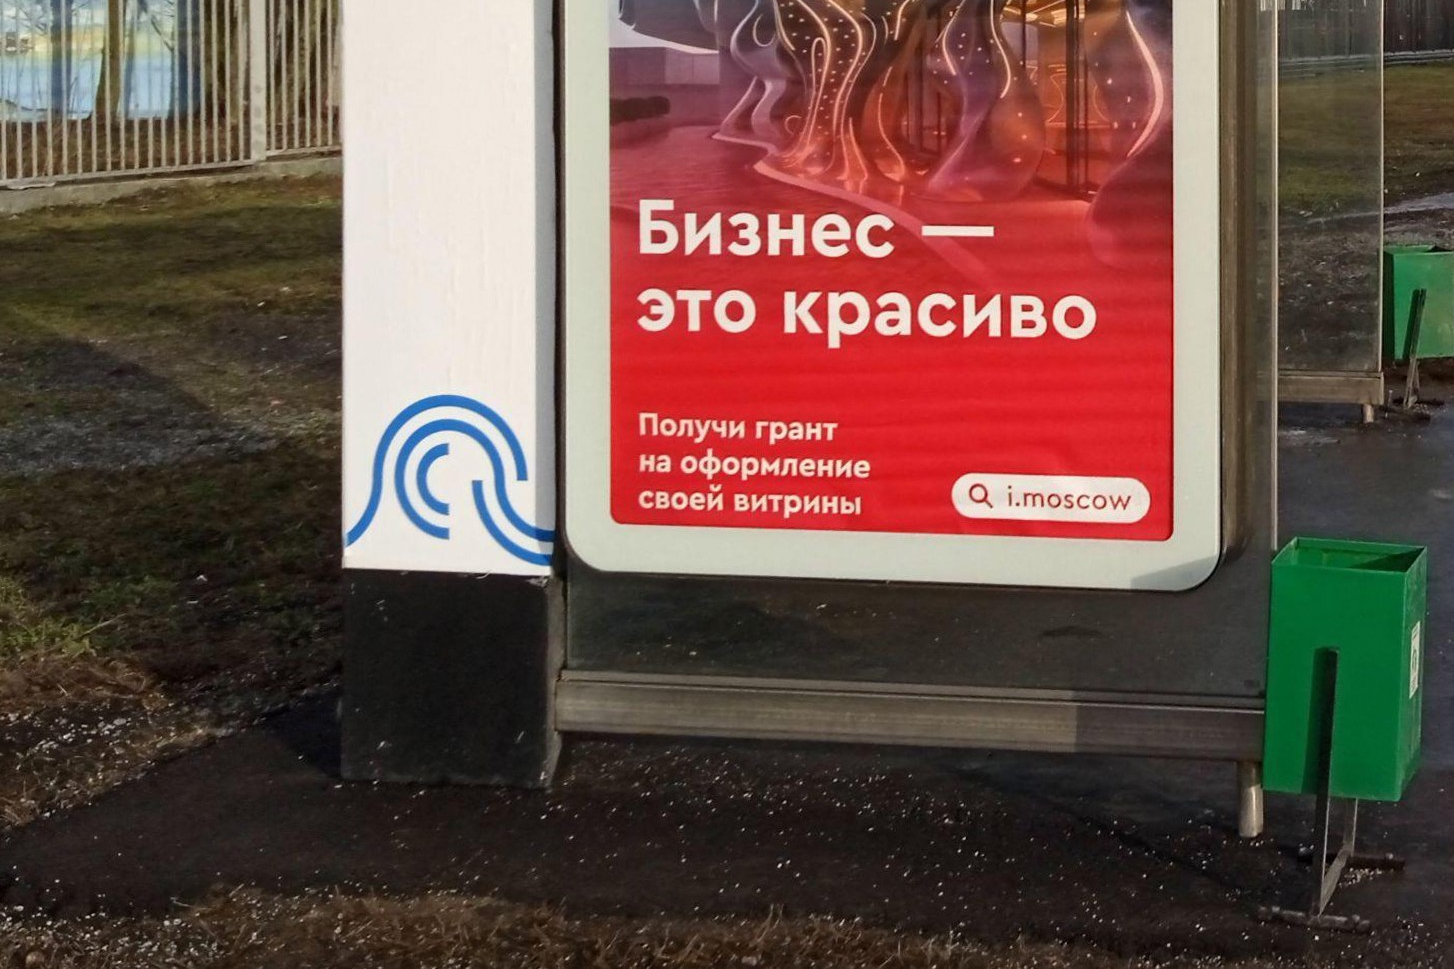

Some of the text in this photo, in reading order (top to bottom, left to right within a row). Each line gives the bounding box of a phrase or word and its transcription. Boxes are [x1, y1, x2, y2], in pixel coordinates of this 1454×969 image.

[639, 199, 895, 259] Бизнес
[637, 287, 1097, 349] это красиво
[638, 412, 838, 445] Получи грант
[638, 448, 871, 480] на оформление
[638, 484, 862, 519] своей витрины
[1007, 485, 1132, 511] i.moscow
